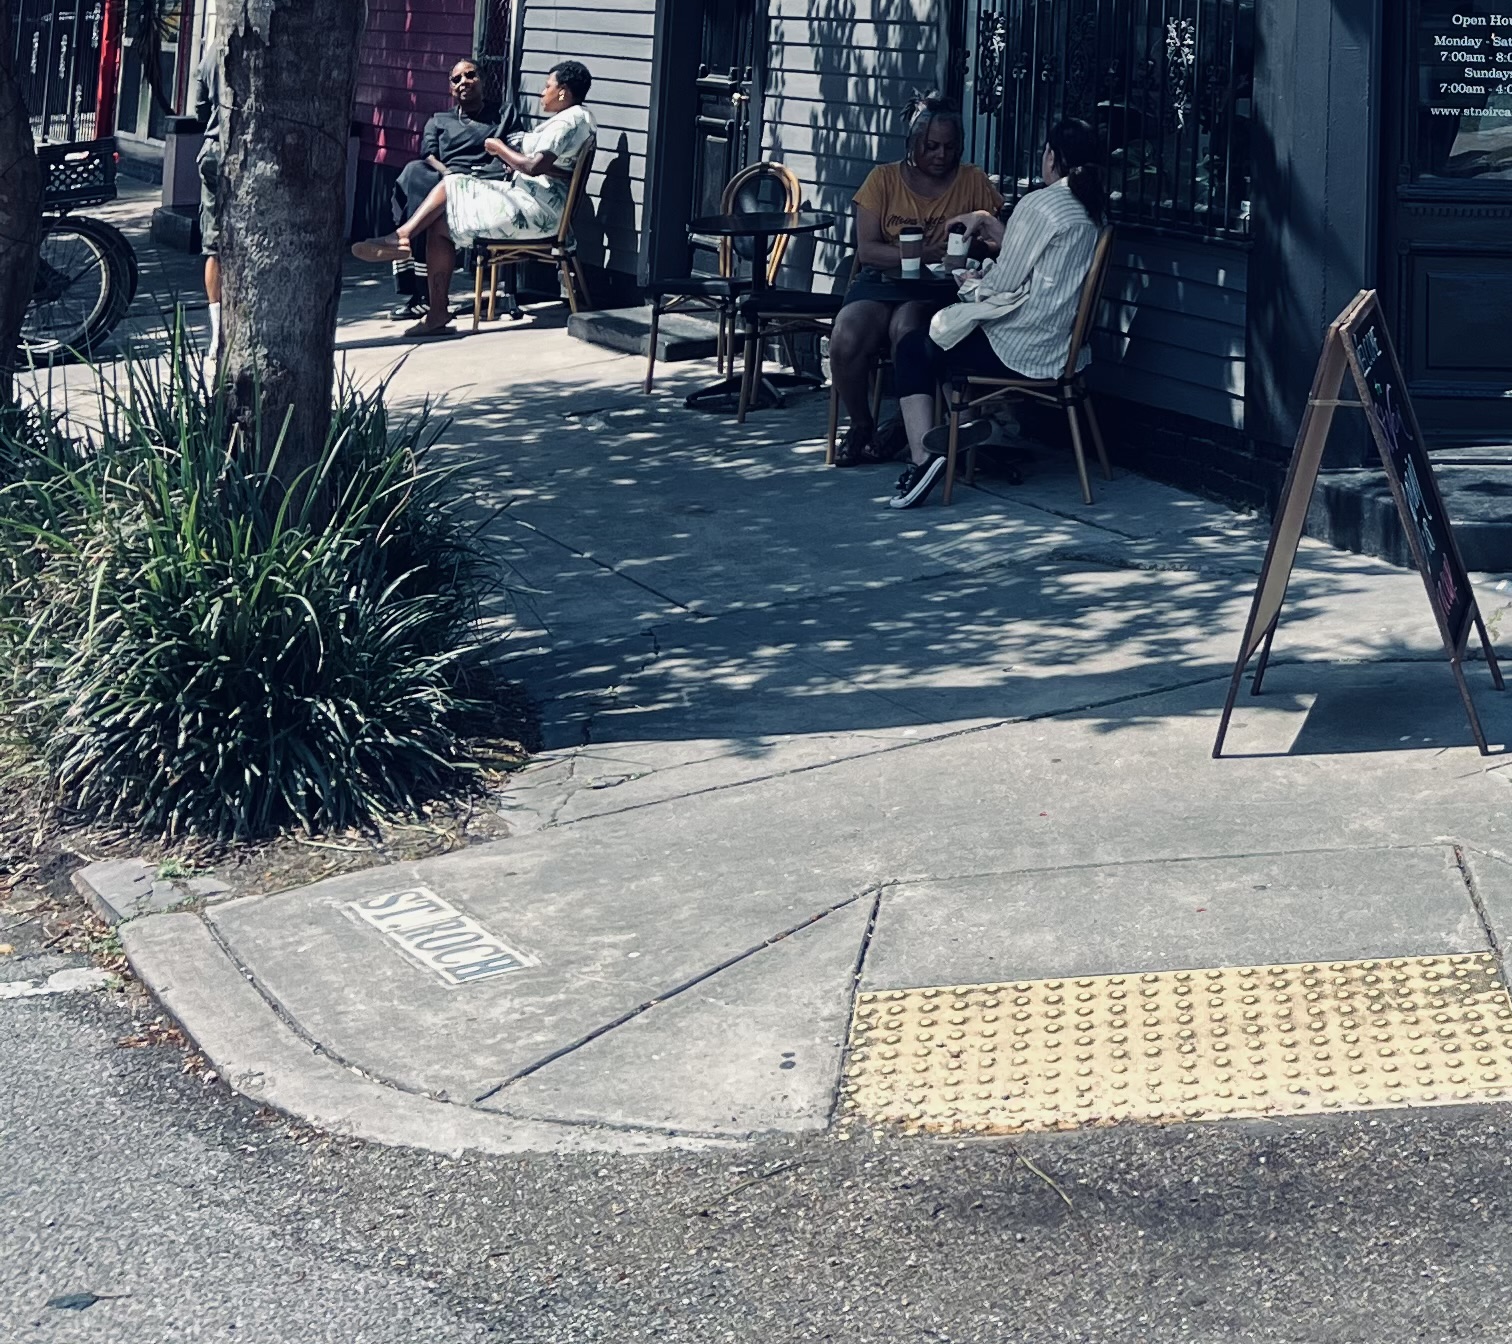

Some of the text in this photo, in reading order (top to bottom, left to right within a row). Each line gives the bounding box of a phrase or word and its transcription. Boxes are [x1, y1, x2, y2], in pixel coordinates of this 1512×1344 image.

[1451, 14, 1487, 28] Open
[1434, 35, 1483, 49] Monday
[1440, 51, 1486, 63] 7:00am
[1439, 82, 1486, 94] 7:00am
[358, 890, 525, 981] ST. ROCH
